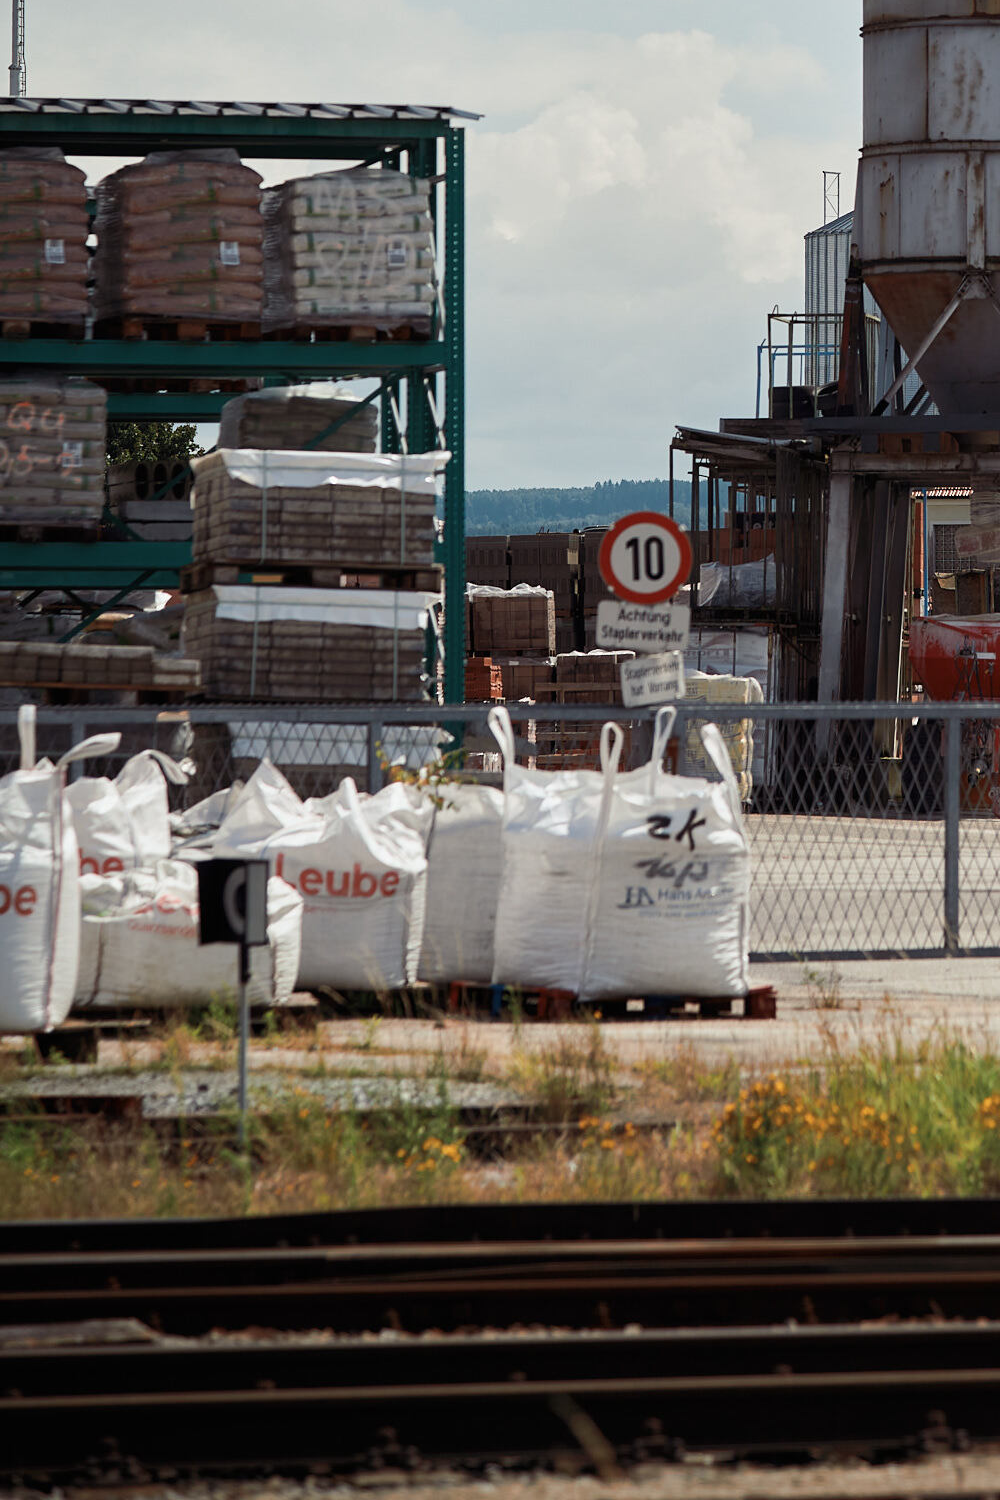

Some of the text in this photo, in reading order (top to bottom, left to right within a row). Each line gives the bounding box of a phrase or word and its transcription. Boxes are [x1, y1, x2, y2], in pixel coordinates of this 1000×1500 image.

[625, 536, 665, 581] 10
[617, 607, 671, 627] Achtung
[601, 624, 684, 643] Staplerverkehr
[276, 852, 400, 898] Leube
